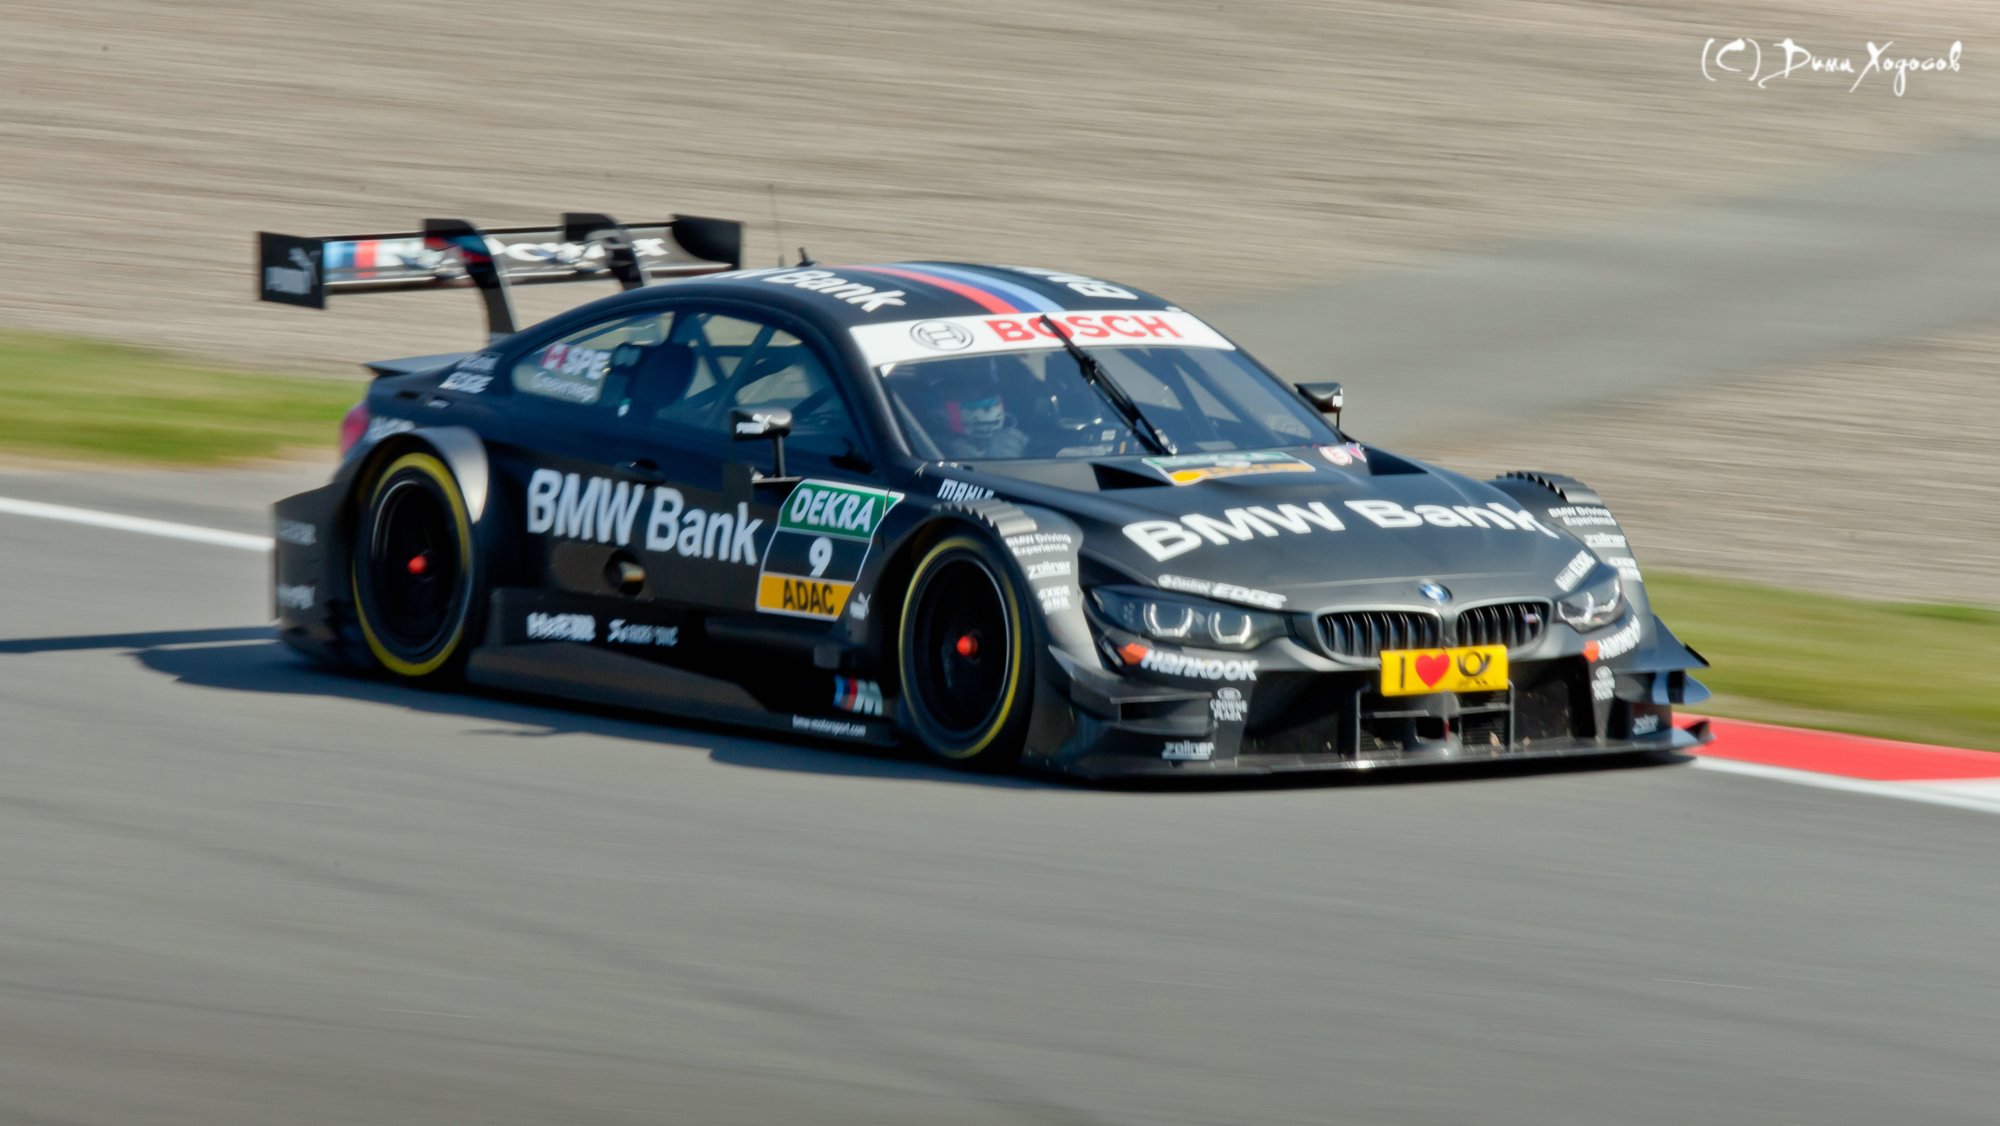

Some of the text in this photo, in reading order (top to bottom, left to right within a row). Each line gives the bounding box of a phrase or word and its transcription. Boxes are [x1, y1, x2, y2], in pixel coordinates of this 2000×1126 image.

[761, 270, 907, 313] Bank
[984, 315, 1184, 343] BOSCH
[527, 468, 764, 567] BMW Bank
[790, 487, 875, 533] DEKRA
[1122, 499, 1561, 562] BMW Bank
[809, 536, 833, 578] 9
[783, 579, 834, 615] ADAC
[1212, 582, 1287, 609] EDGE
